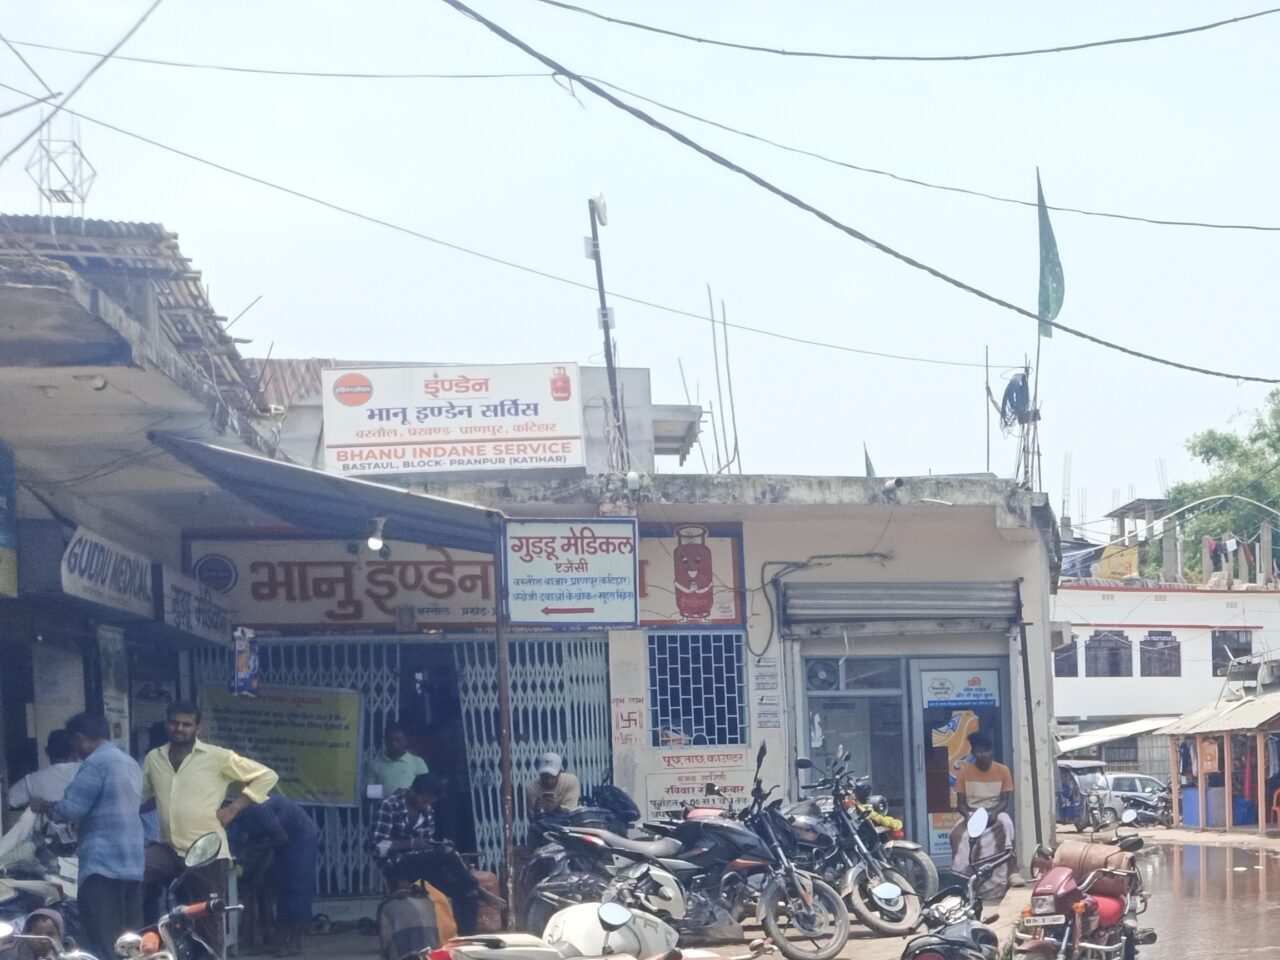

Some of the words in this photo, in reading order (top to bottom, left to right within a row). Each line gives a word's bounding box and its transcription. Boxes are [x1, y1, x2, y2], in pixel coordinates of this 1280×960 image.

[415, 401, 473, 423] इण्डेन
[480, 399, 539, 418] सर्विस
[336, 448, 406, 462] BHANU
[412, 444, 487, 459] INDANE
[493, 442, 572, 456] SERVICE
[342, 462, 399, 471] BASTAUL,
[402, 459, 446, 468] BLOCK-
[450, 456, 506, 466] PRANPUR
[509, 455, 567, 465] (KATIHAR)
[509, 536, 559, 563] गुड्डू
[560, 526, 634, 555] मेडिकल
[250, 560, 358, 621] भानु
[364, 544, 495, 616] इण्डेन
